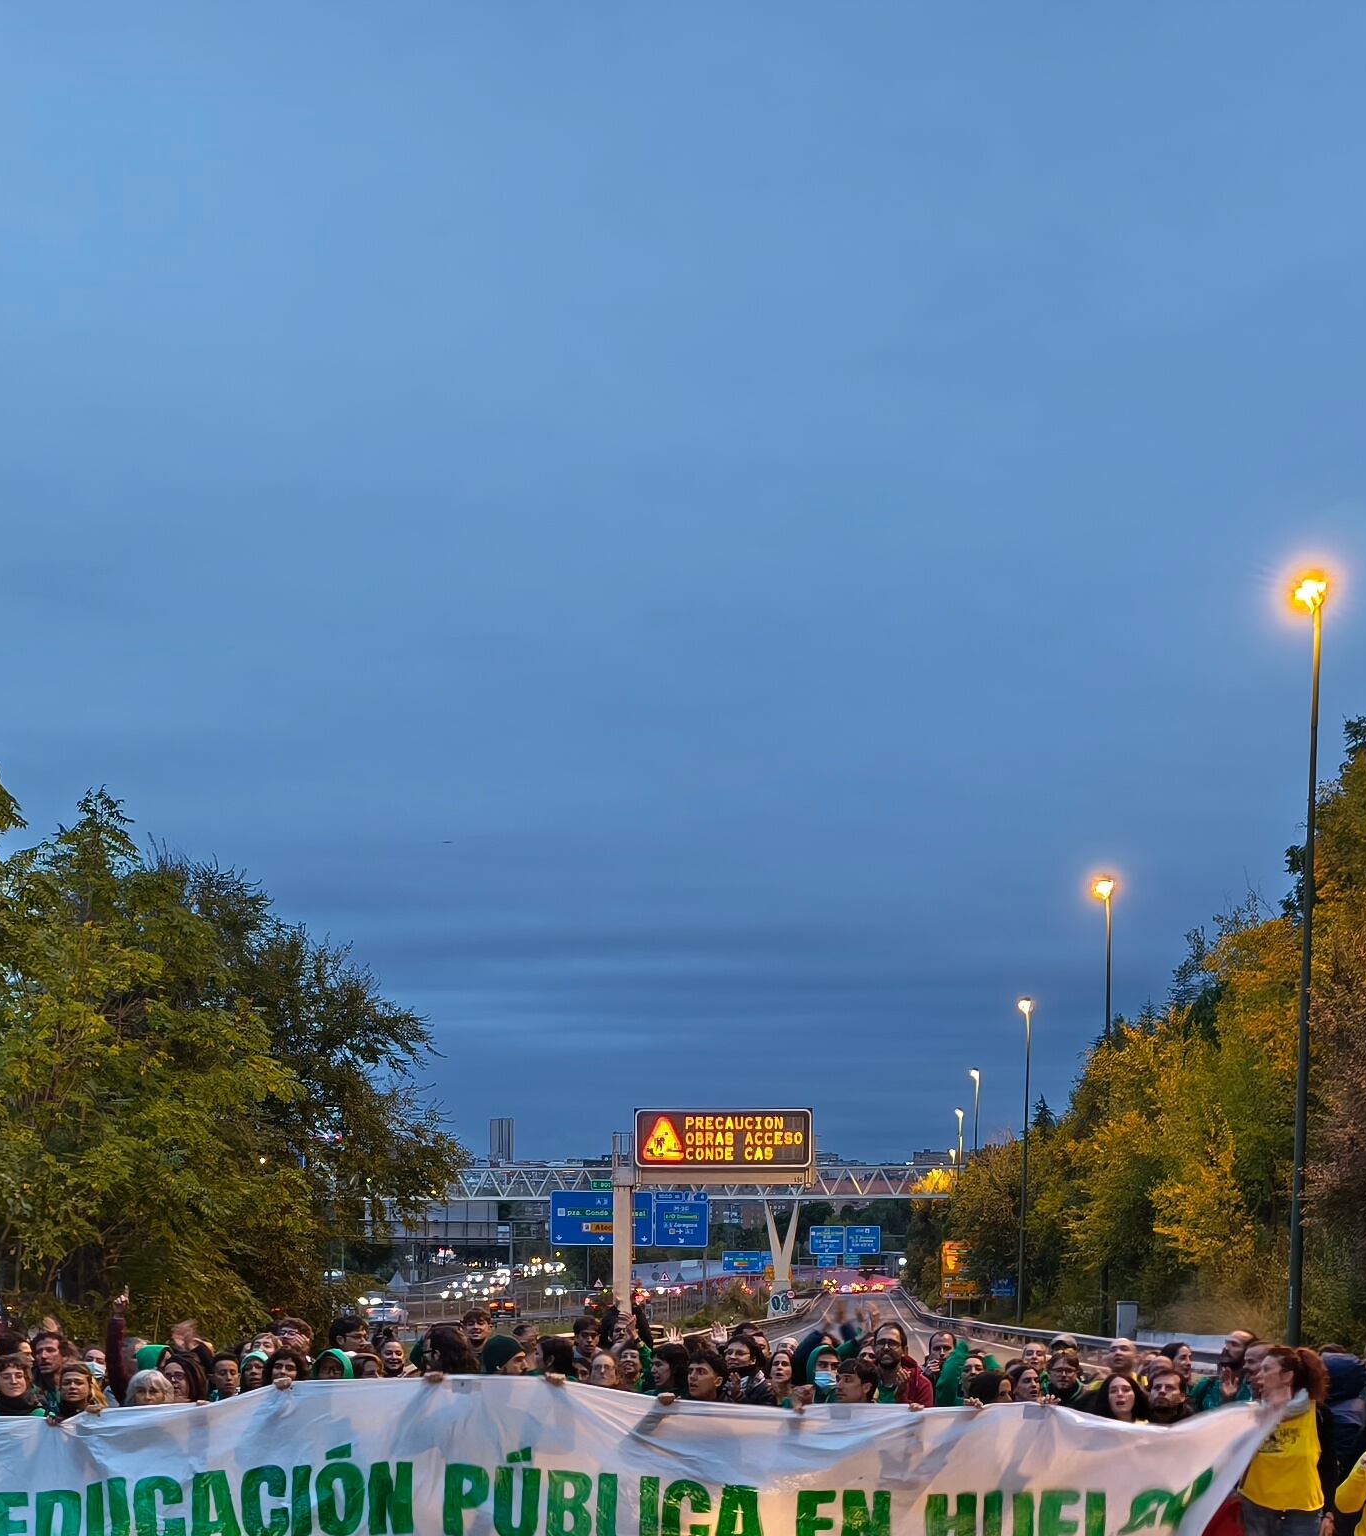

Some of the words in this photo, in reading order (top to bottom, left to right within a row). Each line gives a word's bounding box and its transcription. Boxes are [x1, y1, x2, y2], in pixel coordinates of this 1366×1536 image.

[685, 1116, 784, 1130] PRECAUCION
[685, 1131, 734, 1145] OBRAS
[744, 1131, 803, 1145] ACCESO
[685, 1147, 734, 1161] CONDE
[744, 1147, 774, 1161] CAS
